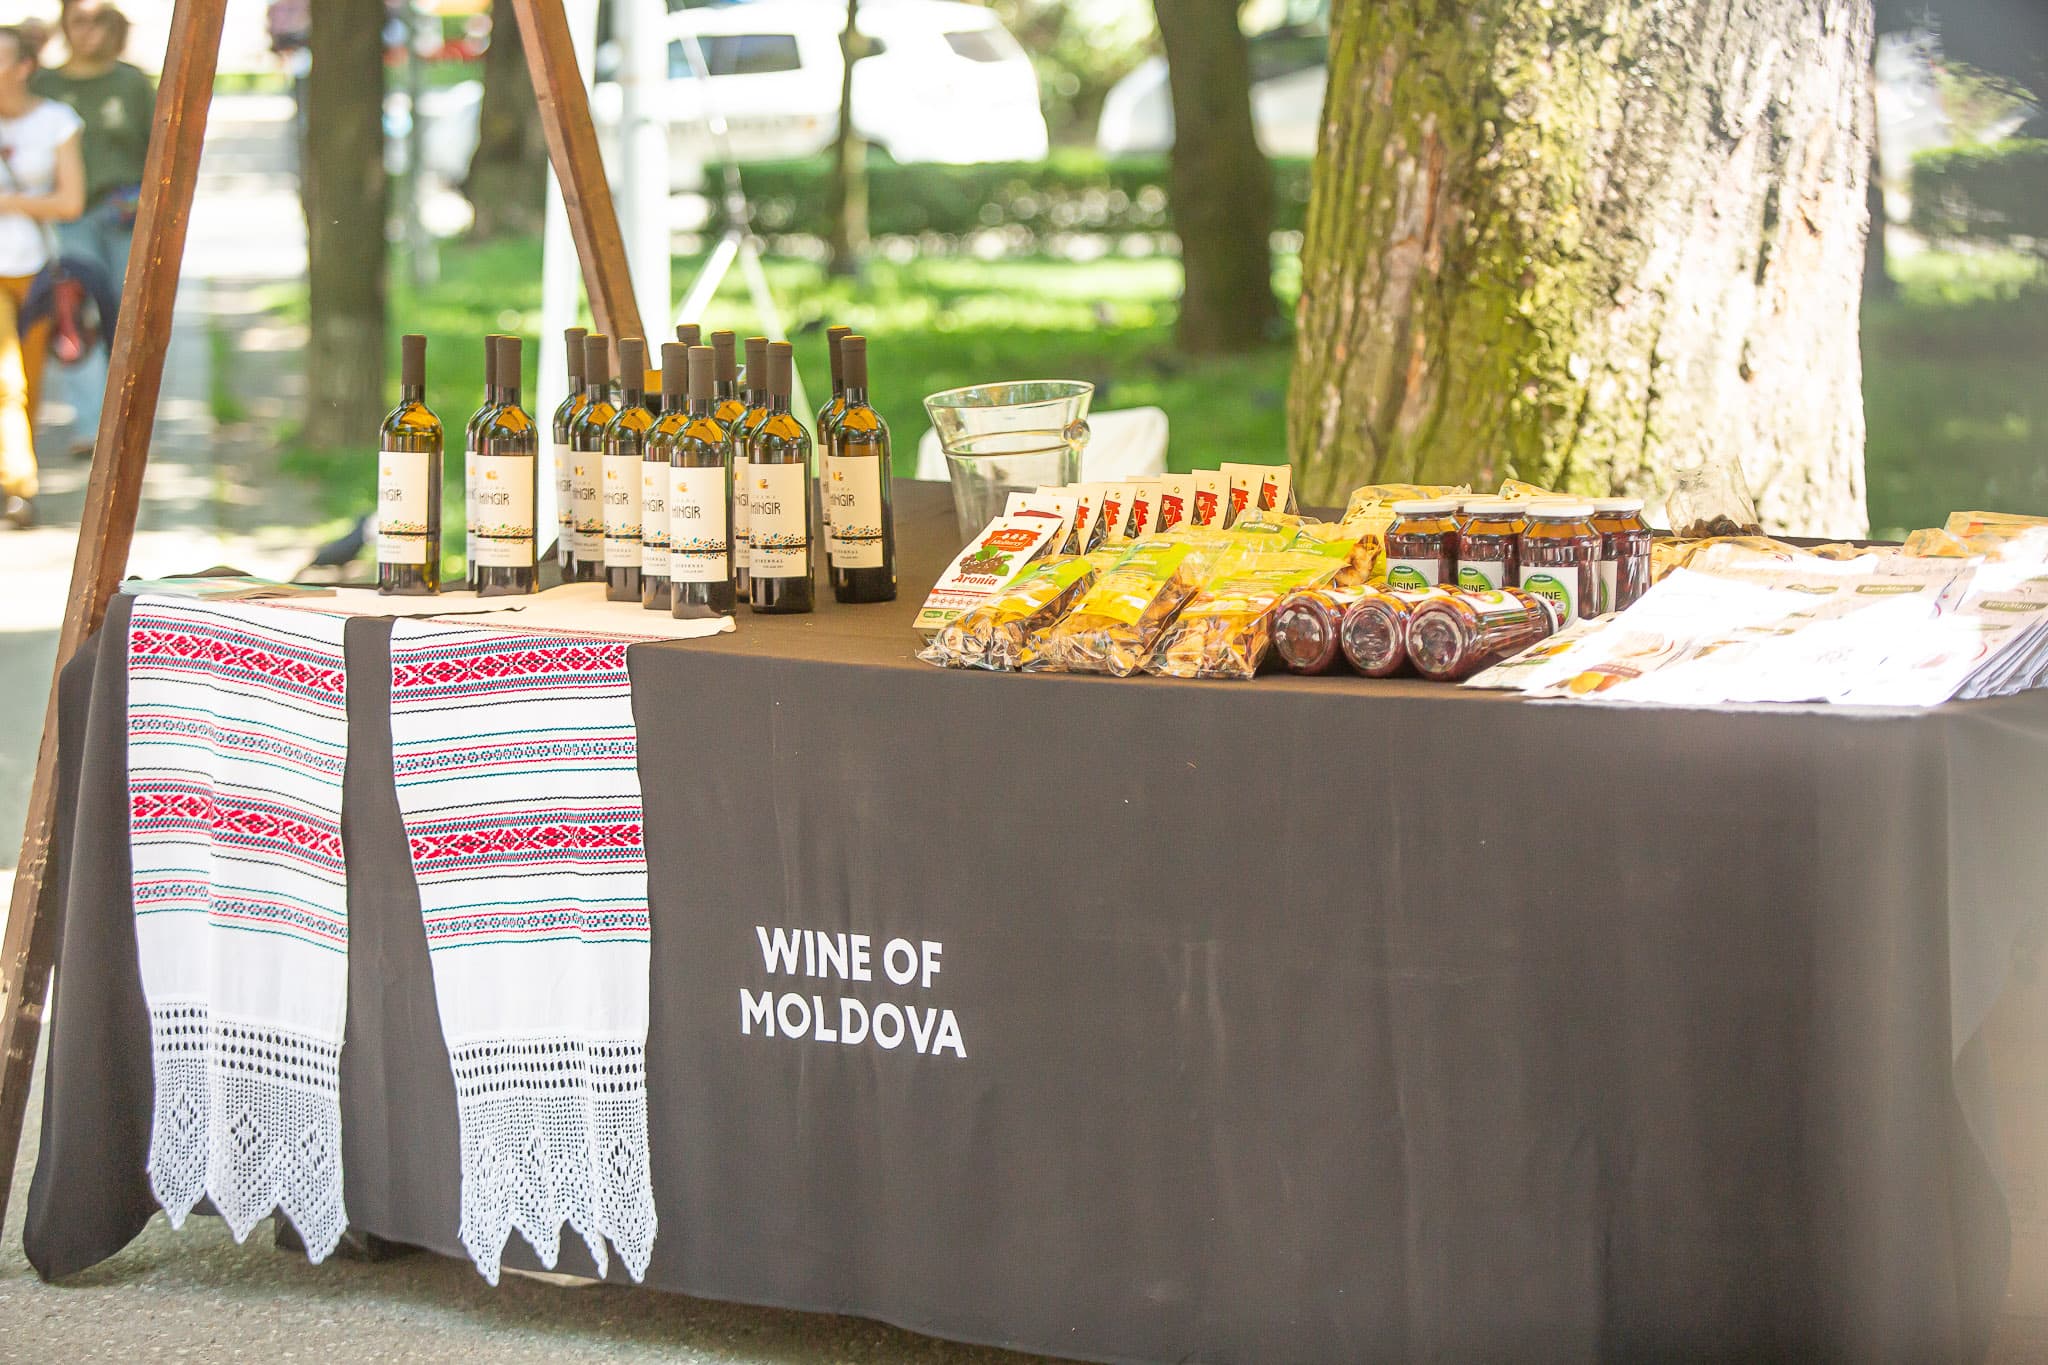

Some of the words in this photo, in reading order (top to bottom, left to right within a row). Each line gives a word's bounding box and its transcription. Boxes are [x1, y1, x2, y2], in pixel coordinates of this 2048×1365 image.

[951, 573, 999, 586] Aronia
[755, 925, 872, 982] WINE
[883, 937, 943, 988] OF
[739, 988, 968, 1058] MOLDOVA
